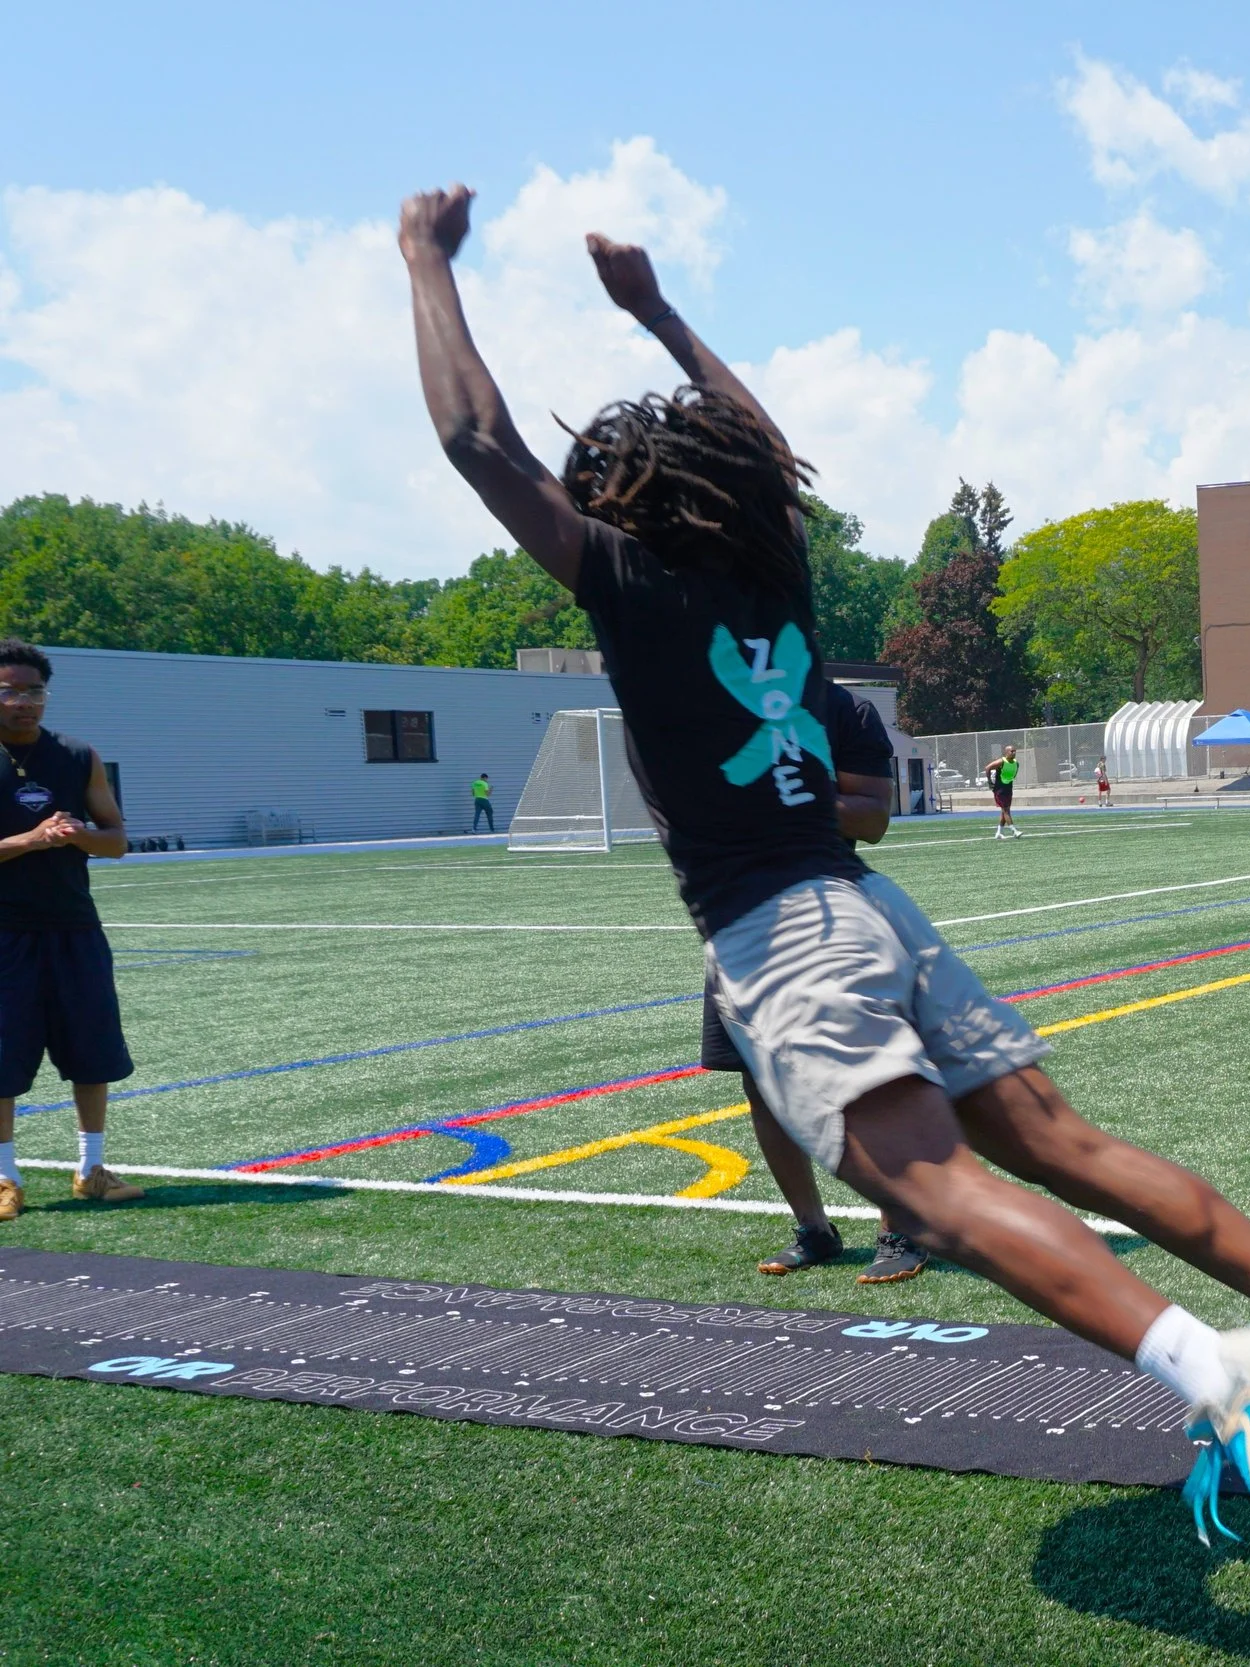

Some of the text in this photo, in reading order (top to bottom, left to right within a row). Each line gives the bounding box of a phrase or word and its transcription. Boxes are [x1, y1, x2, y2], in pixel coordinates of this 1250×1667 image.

[743, 638, 816, 807] ZONE
[339, 1282, 988, 1343] OVR PERFORMANCE
[88, 1356, 806, 1442] OVR PERFORMANCE
[1046, 1427, 1066, 1435] 3
[1193, 1439, 1212, 1447] 2
